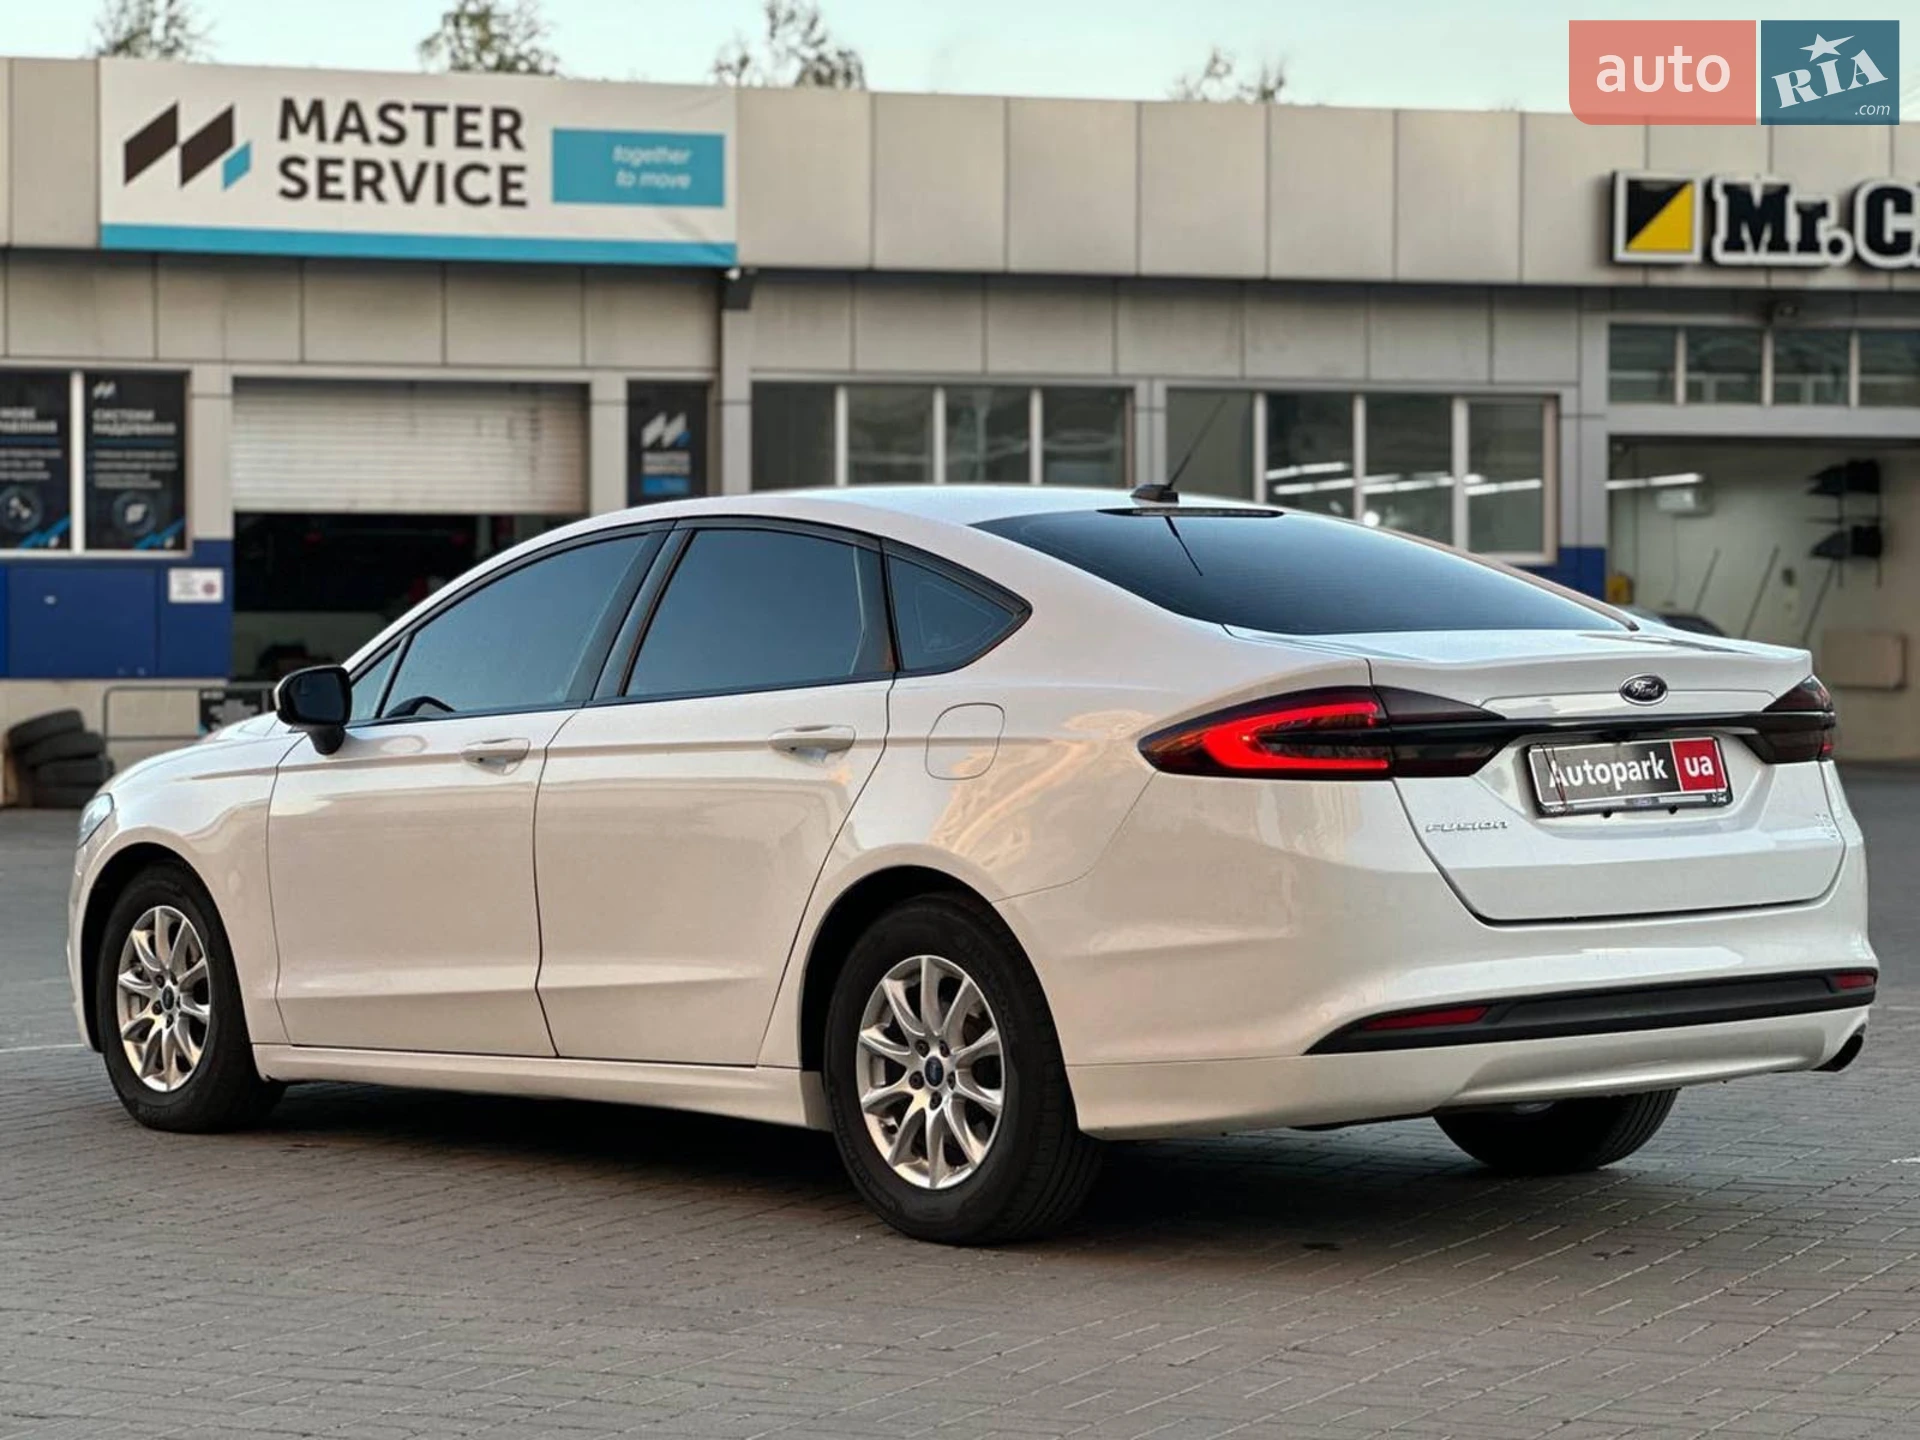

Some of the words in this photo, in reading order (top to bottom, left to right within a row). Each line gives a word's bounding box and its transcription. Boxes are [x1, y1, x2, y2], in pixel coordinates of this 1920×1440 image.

[278, 96, 526, 151] MASTER
[612, 144, 693, 169] together
[278, 155, 529, 208] SERVICE
[615, 169, 637, 189] to
[640, 172, 692, 190] move
[1624, 680, 1660, 698] Ford
[1549, 750, 1669, 791] Autopark
[1684, 755, 1715, 778] ua
